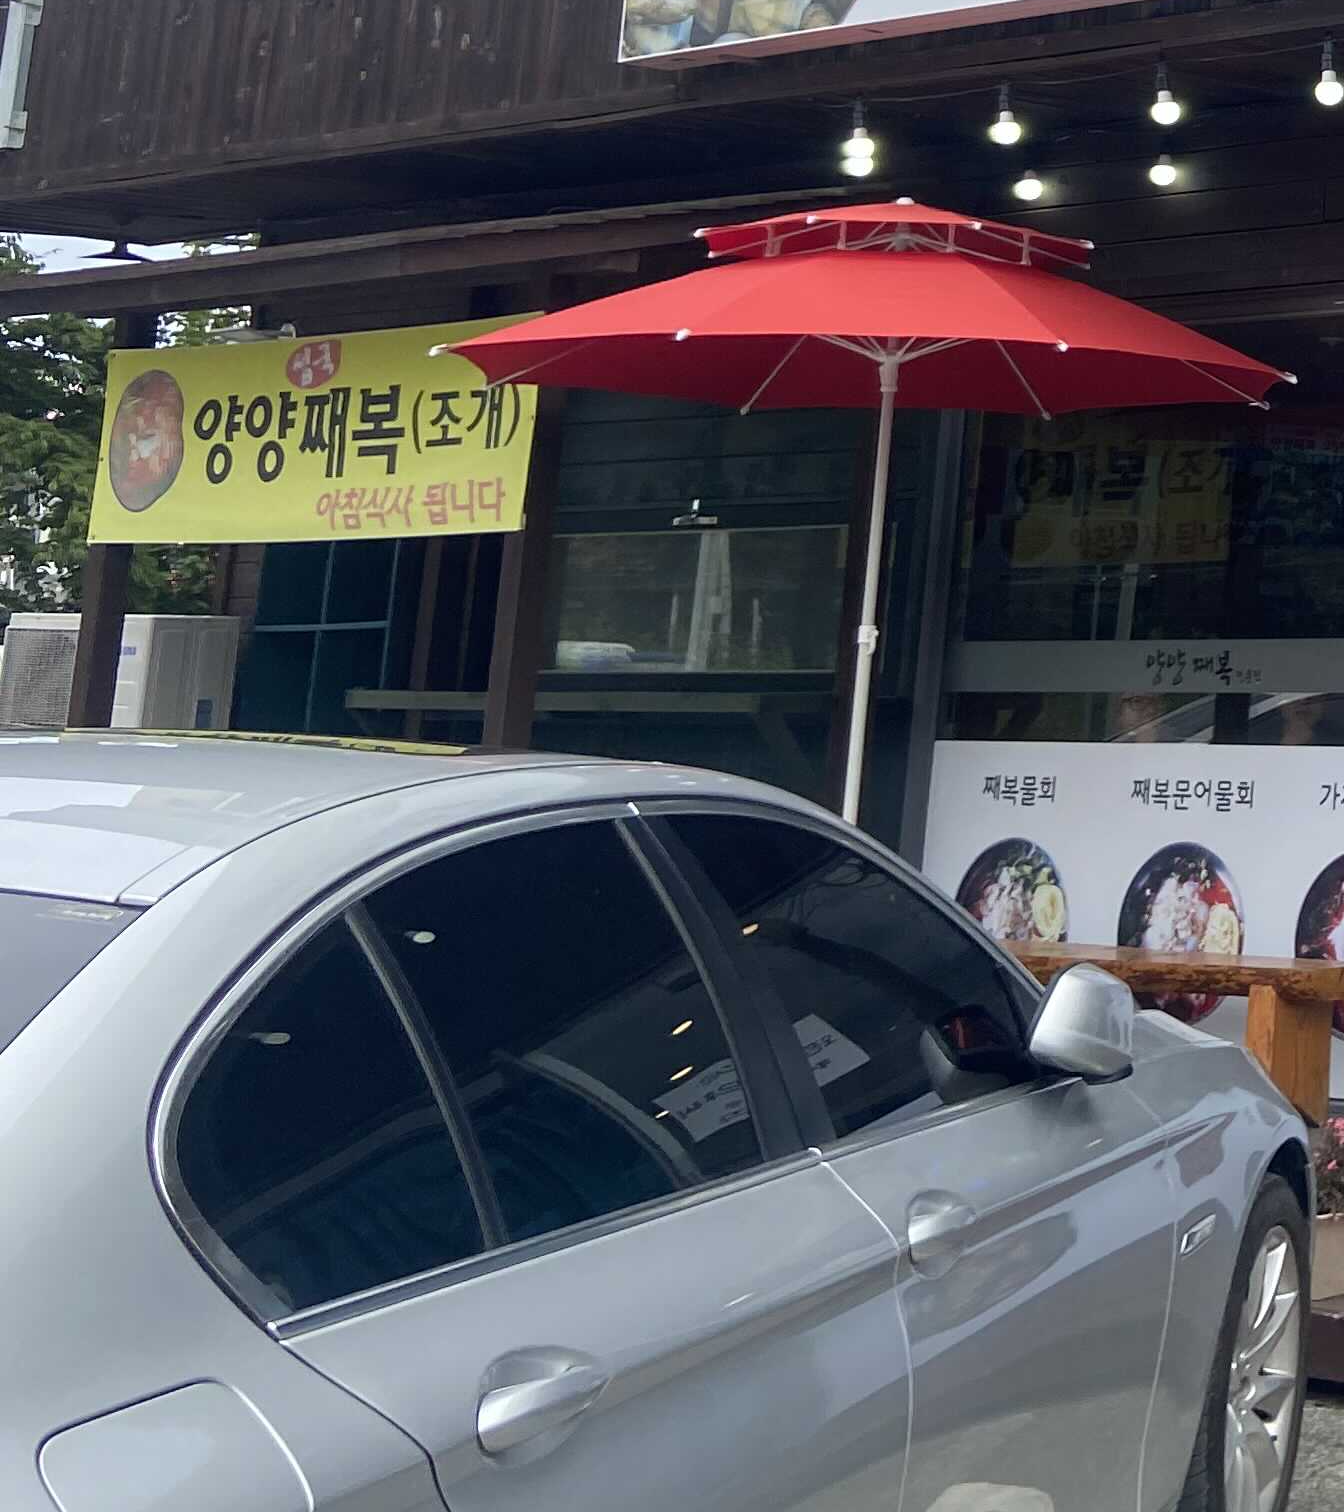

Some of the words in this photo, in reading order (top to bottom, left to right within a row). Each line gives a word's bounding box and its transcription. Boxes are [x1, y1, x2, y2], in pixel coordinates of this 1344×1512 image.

[315, 488, 414, 532] 아침식사
[422, 477, 506, 525] 됩니다
[982, 774, 1057, 808] 째복물회
[1130, 778, 1255, 812] 째복문어물회
